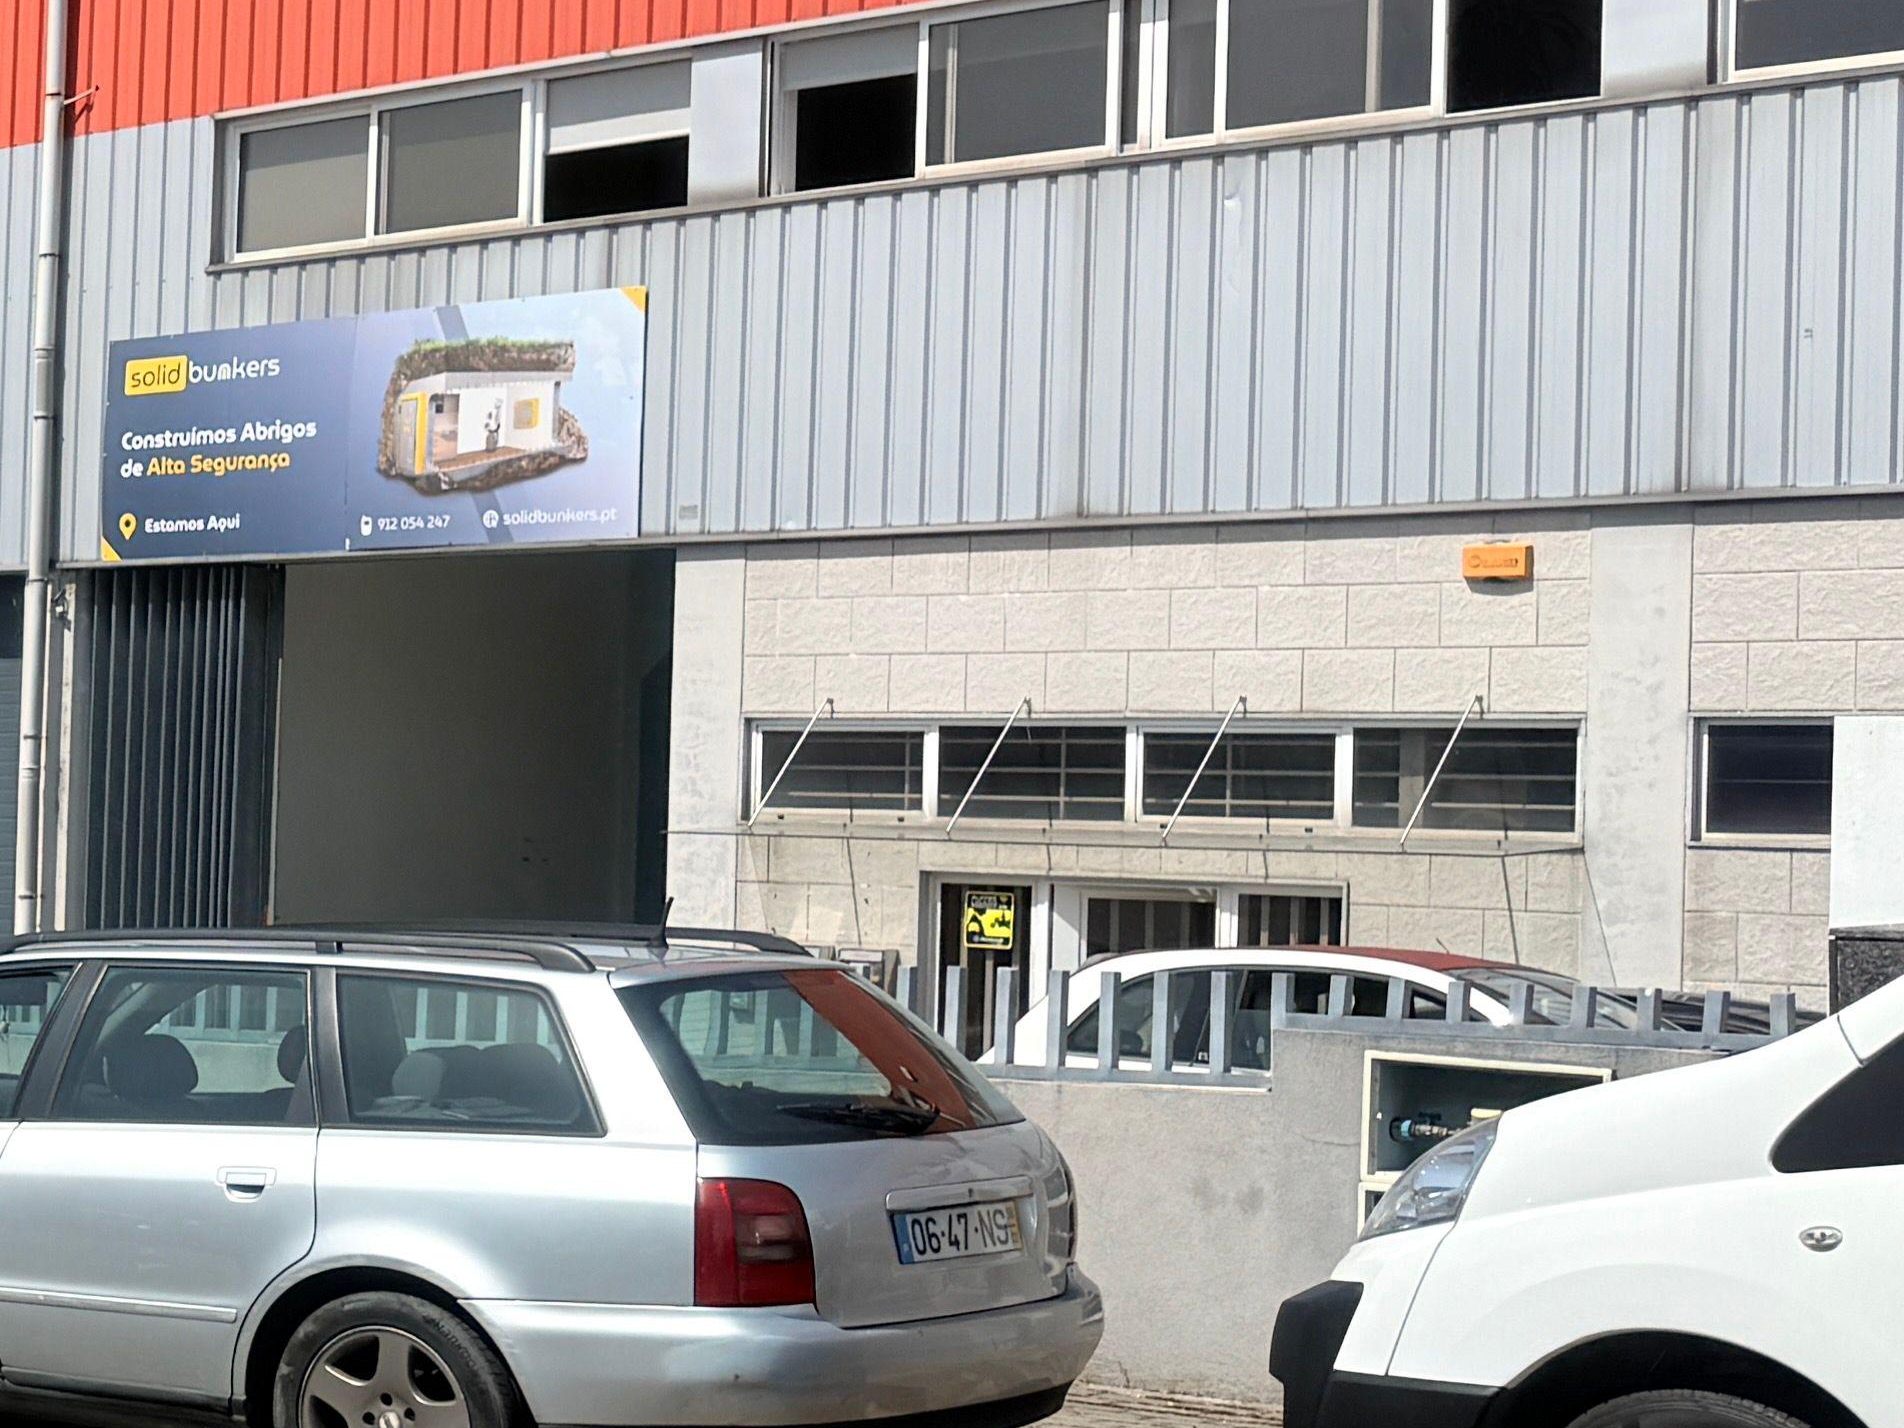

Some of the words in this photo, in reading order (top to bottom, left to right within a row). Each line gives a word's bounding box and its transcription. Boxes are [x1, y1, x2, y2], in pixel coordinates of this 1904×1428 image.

[121, 426, 236, 451] Construímos
[240, 419, 317, 444] Abrigos
[120, 459, 143, 478] de
[146, 455, 185, 477] Alta
[190, 453, 290, 477] Segurança
[144, 518, 204, 534] Estamos
[206, 513, 241, 533] Aqui
[377, 518, 398, 531] 912
[400, 517, 425, 530] 054
[427, 515, 450, 529] 247
[502, 507, 617, 526] solidbunkers.pt
